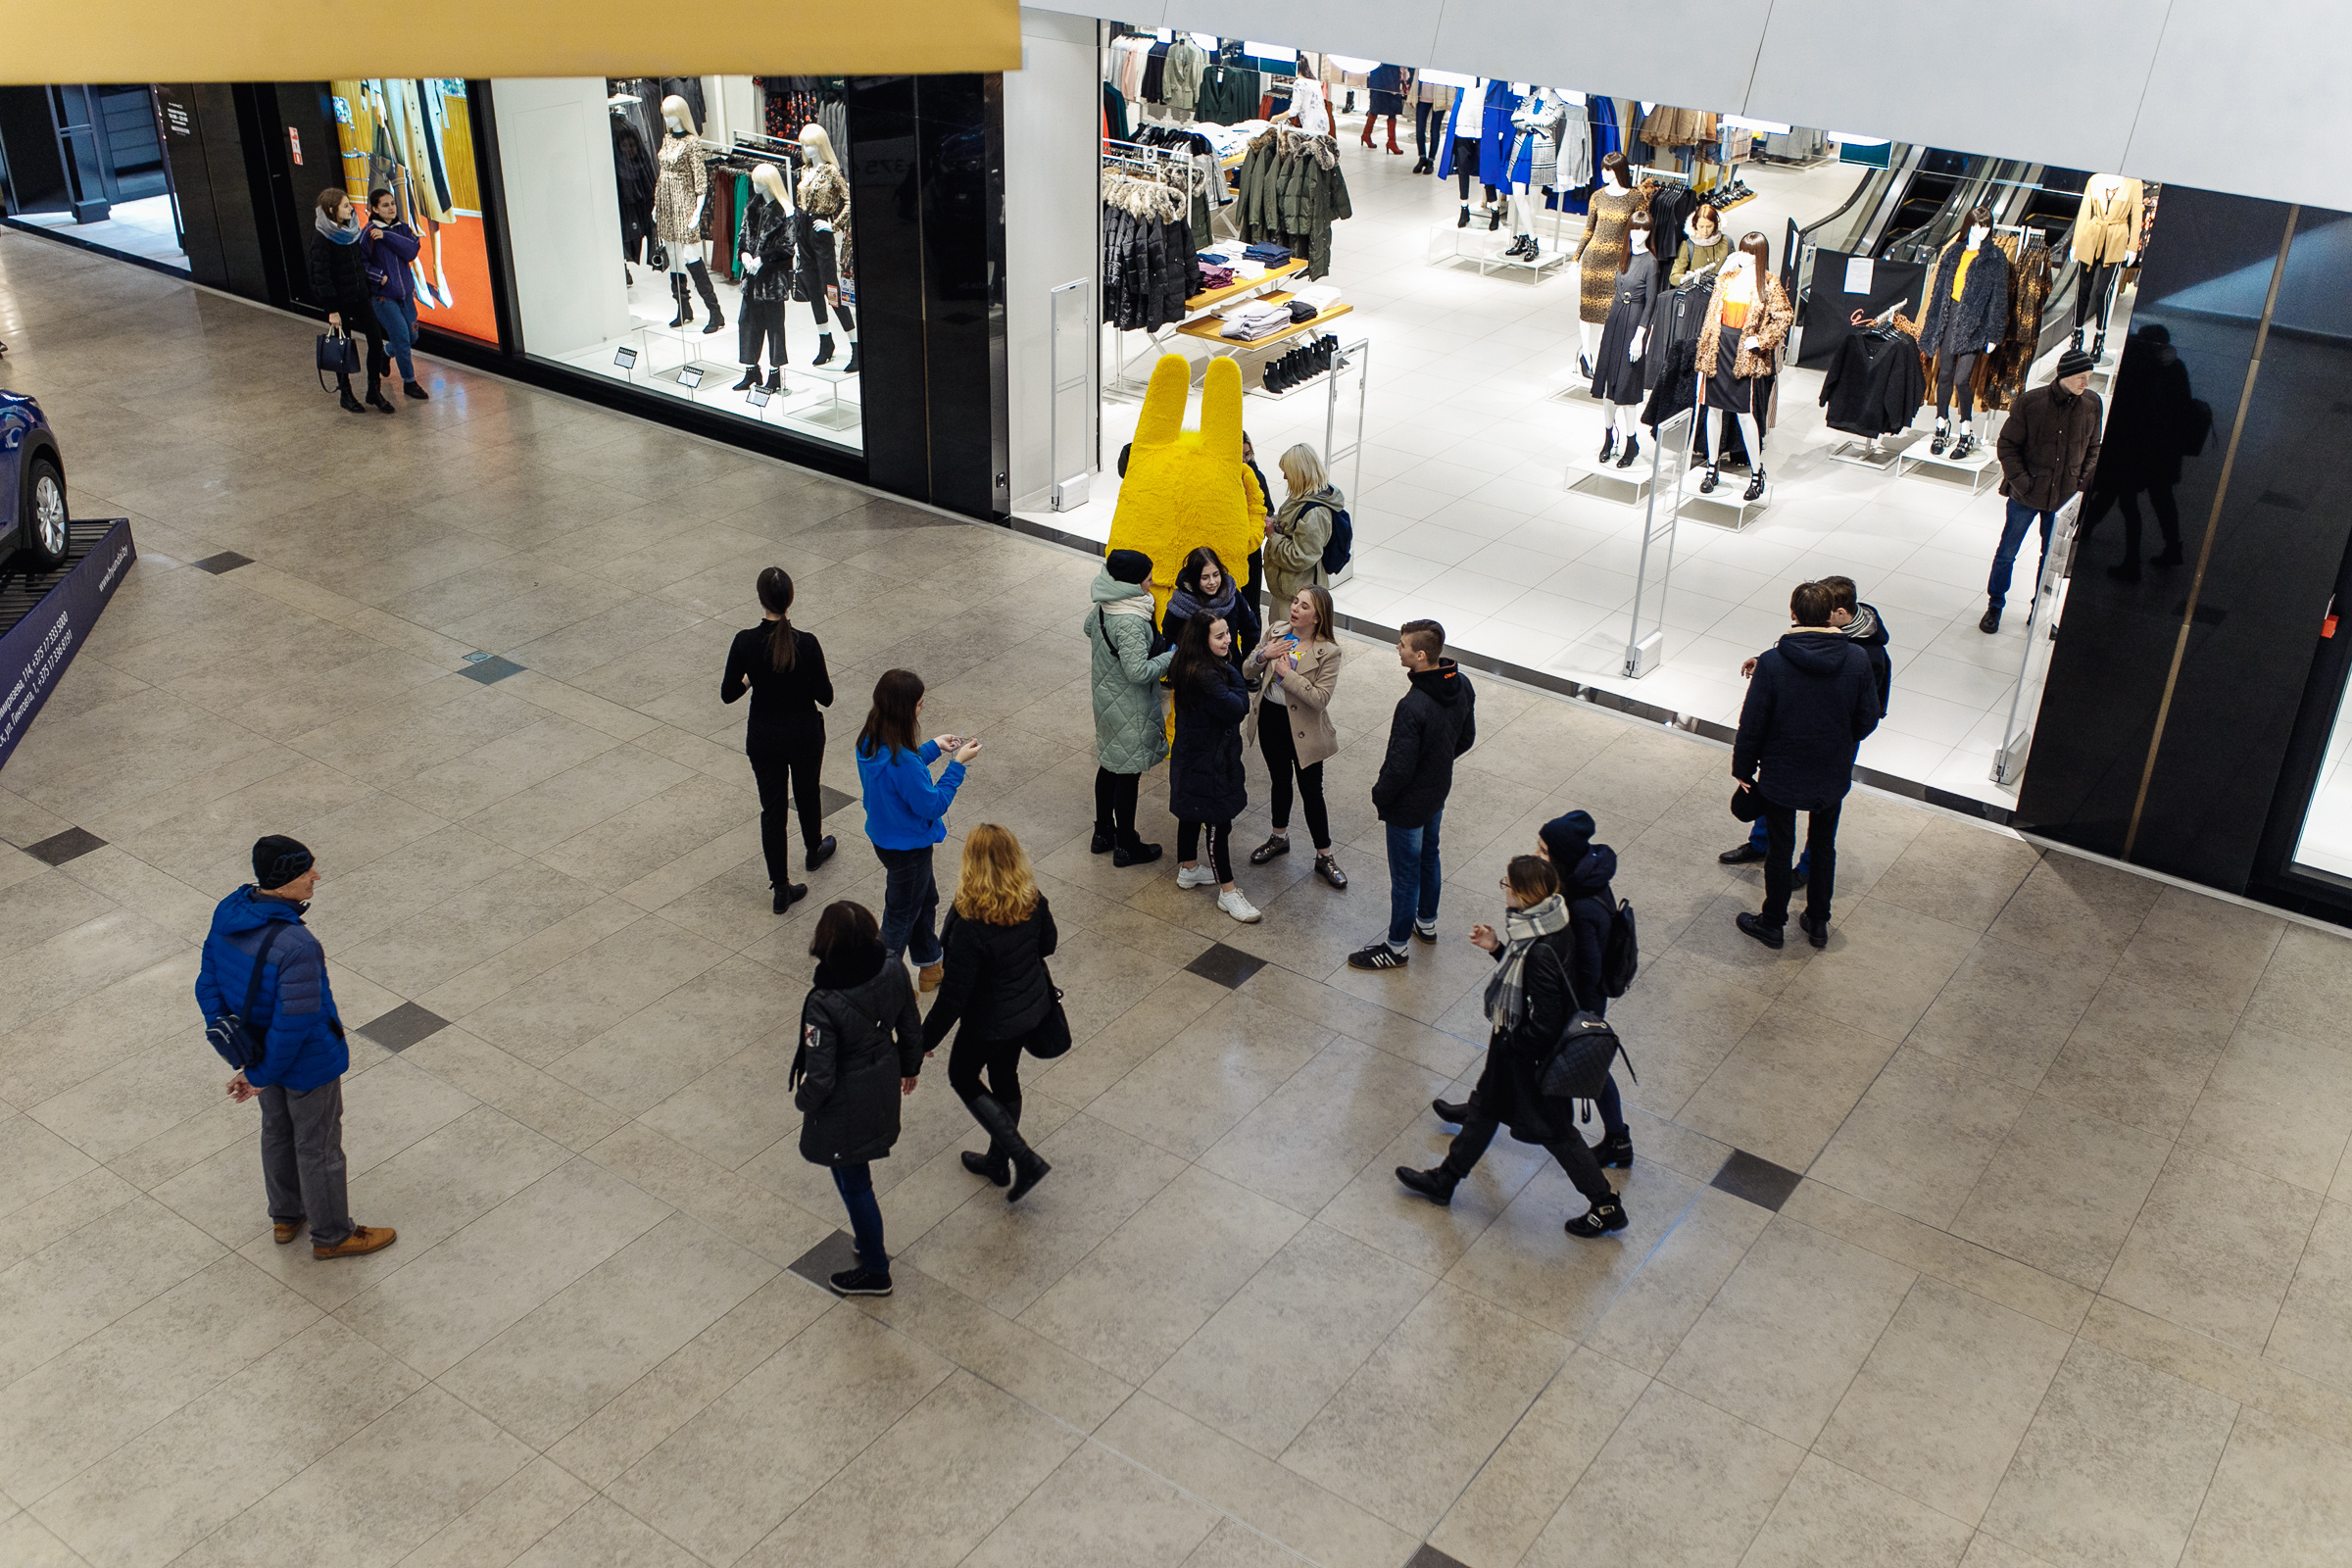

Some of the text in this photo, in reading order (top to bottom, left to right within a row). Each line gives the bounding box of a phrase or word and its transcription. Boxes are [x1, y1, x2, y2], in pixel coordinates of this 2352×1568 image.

[98, 544, 128, 593] www.hyundai.by
[31, 645, 45, 668] +375
[42, 636, 50, 653] 17
[48, 625, 59, 645] 333
[37, 663, 50, 687] +375
[47, 655, 55, 670] 17
[52, 643, 63, 663] 336
[61, 628, 74, 651] 8191
